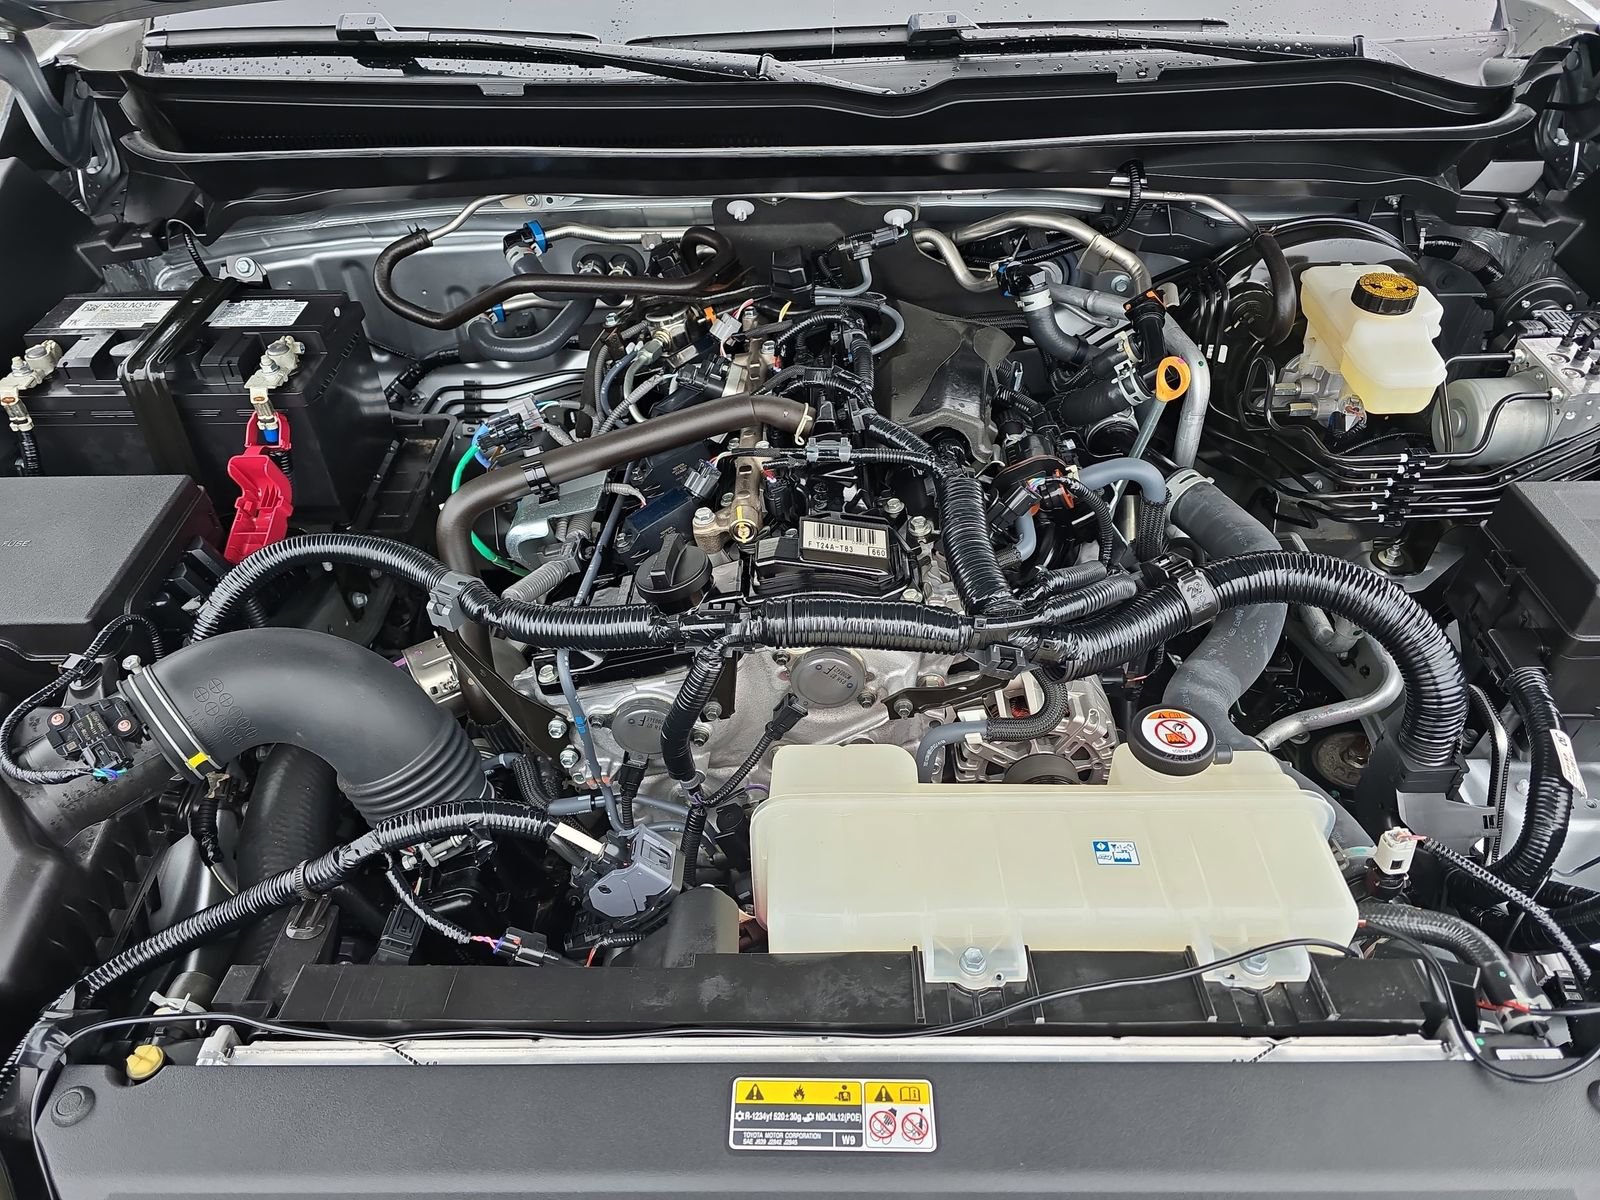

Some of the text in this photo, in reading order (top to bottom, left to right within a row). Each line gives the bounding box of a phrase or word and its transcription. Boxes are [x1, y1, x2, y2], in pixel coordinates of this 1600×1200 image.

[871, 549, 885, 557] 660
[743, 1131, 763, 1139] TOYOTA
[784, 1132, 822, 1140] CORPORATION
[841, 1134, 856, 1146] W9
